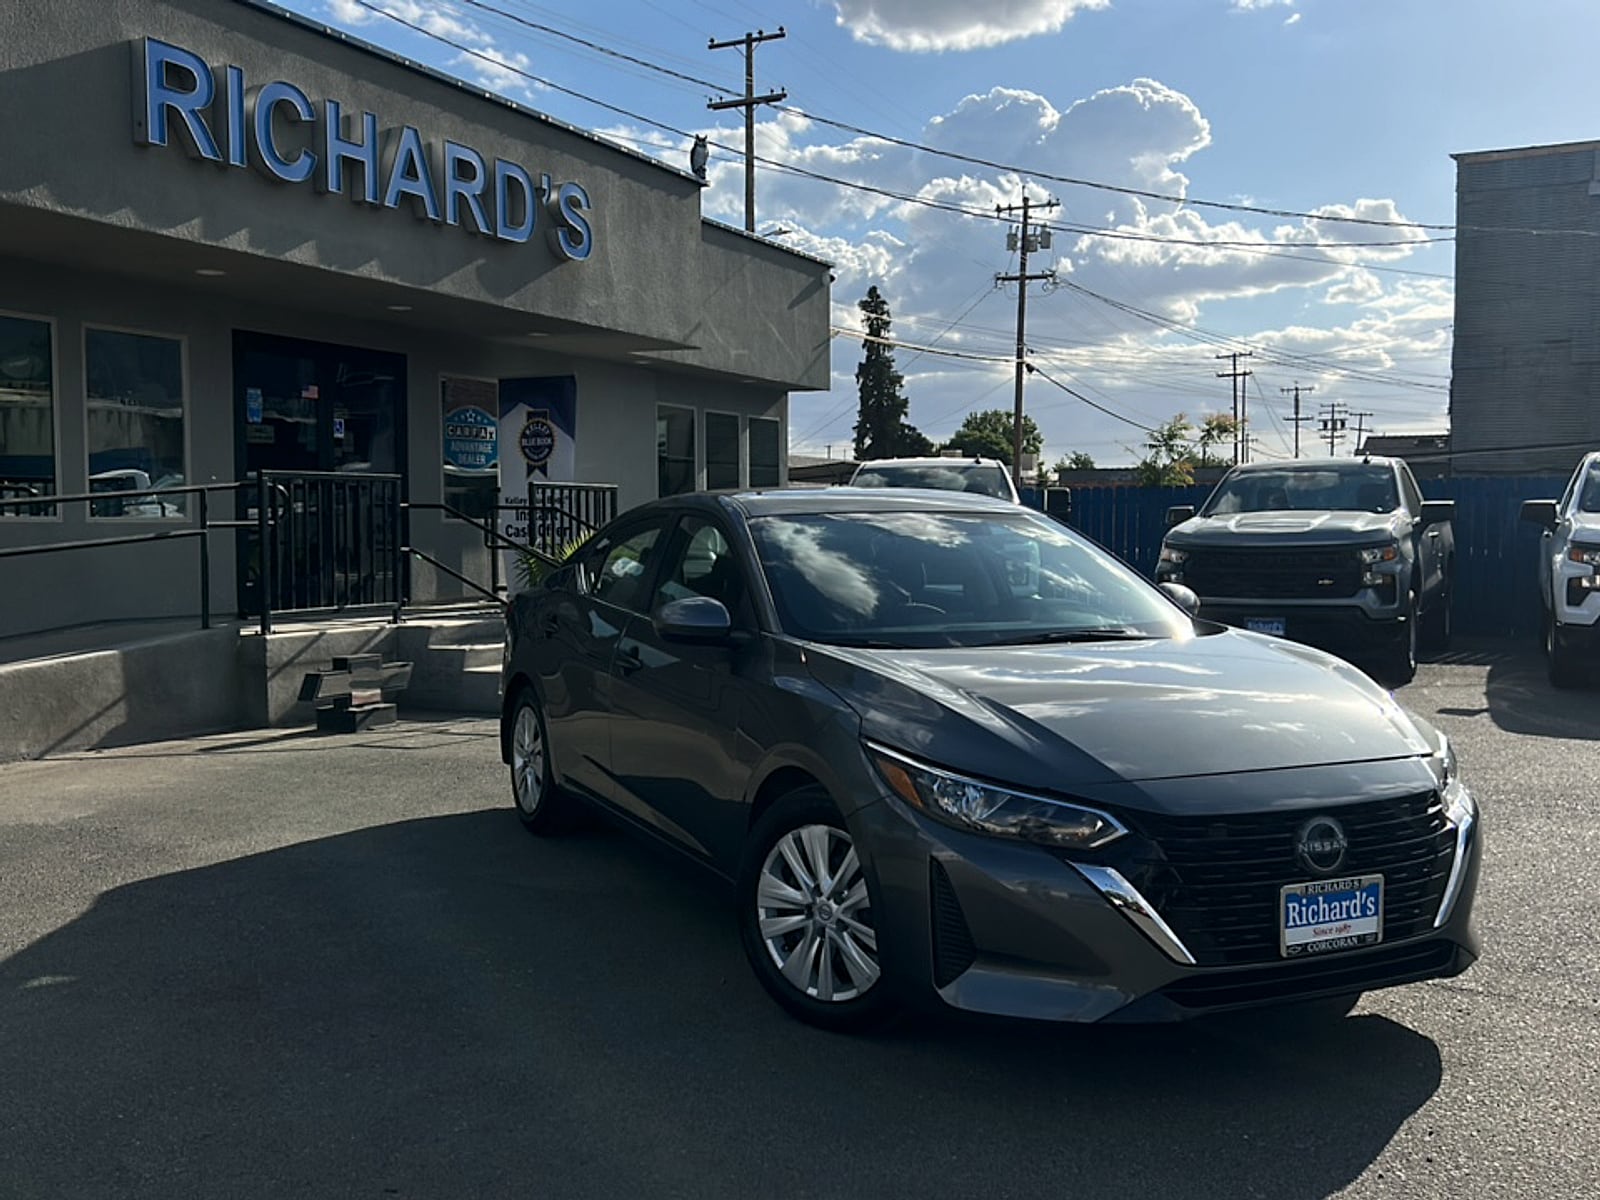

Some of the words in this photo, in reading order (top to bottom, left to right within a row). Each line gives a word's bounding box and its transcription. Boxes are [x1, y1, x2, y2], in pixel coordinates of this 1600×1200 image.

[144, 36, 592, 261] RICHARD'S
[447, 424, 496, 440] CARFAX
[524, 422, 550, 435] KELLEY
[450, 441, 493, 453] ADVANTAGE
[521, 437, 536, 447] BLUE
[537, 436, 552, 446] BOOK
[458, 453, 486, 465] DEALER
[505, 496, 528, 507] Kelley
[505, 524, 535, 538] Cas
[1298, 840, 1348, 852] NISSAN
[1287, 891, 1375, 927] Richard's
[1313, 926, 1334, 936] Since
[1307, 936, 1358, 952] CORCORAN
